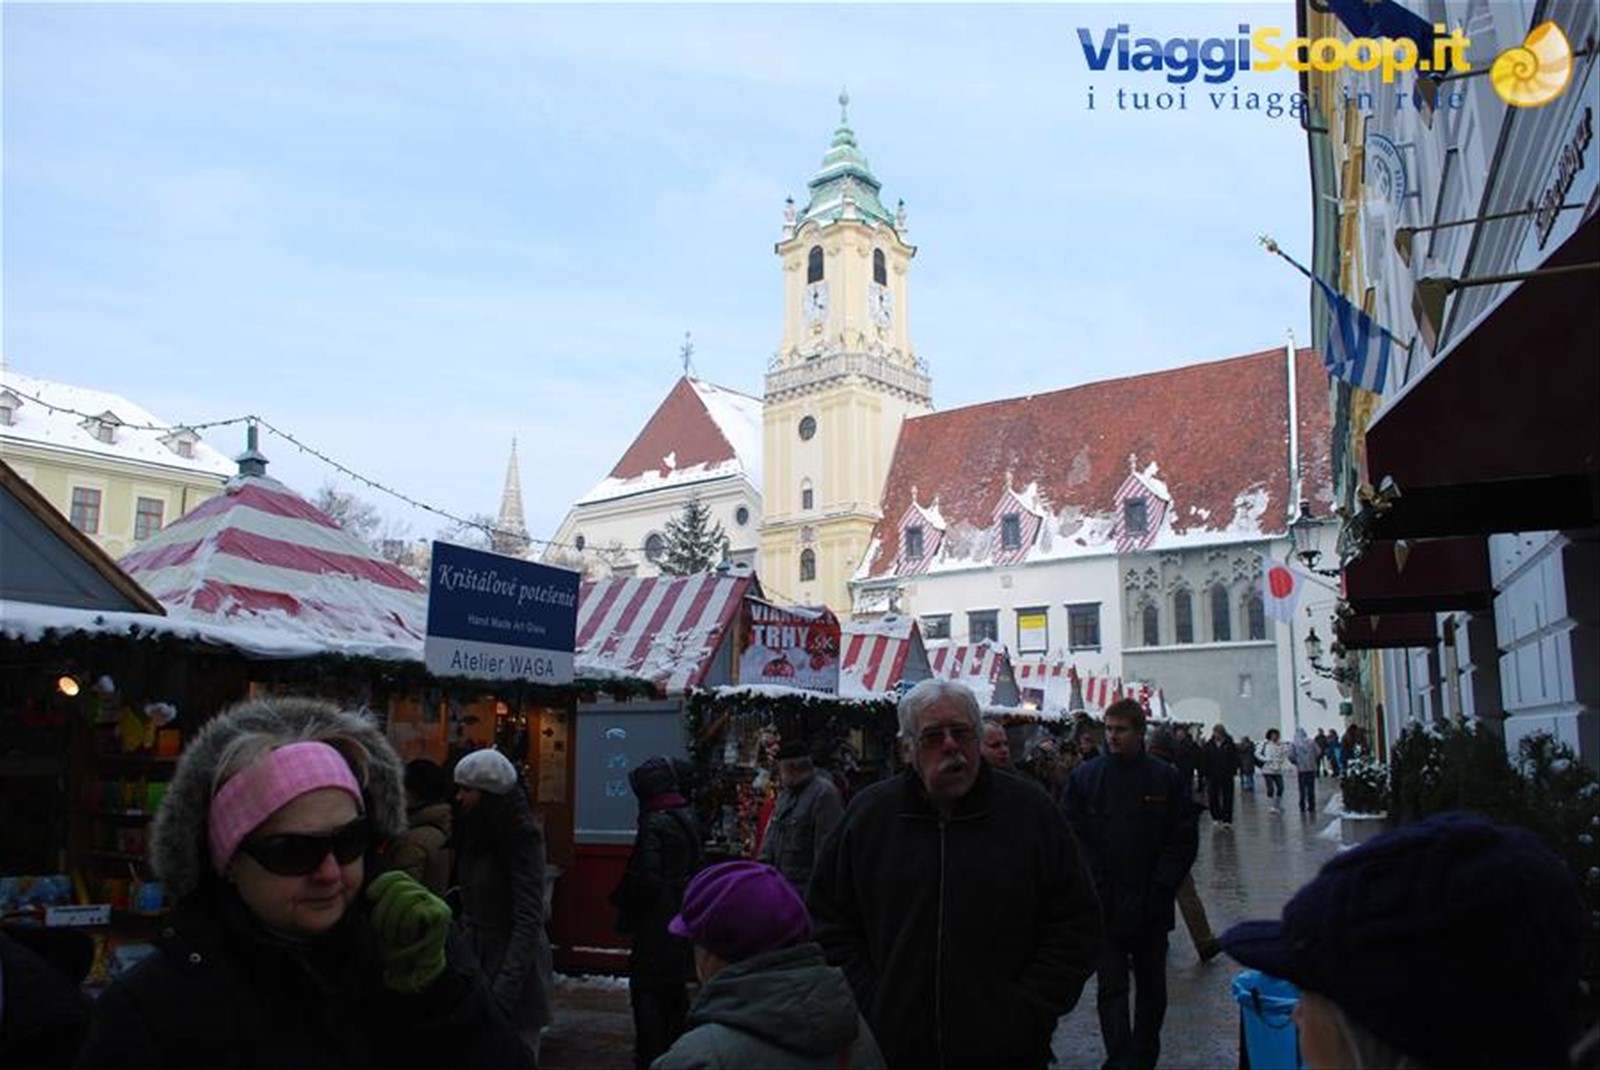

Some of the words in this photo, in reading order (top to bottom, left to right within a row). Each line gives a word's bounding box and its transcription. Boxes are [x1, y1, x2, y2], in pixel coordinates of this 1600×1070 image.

[752, 624, 810, 648] TRHY
[451, 649, 505, 672] Atelier
[509, 655, 555, 677] WAGA
